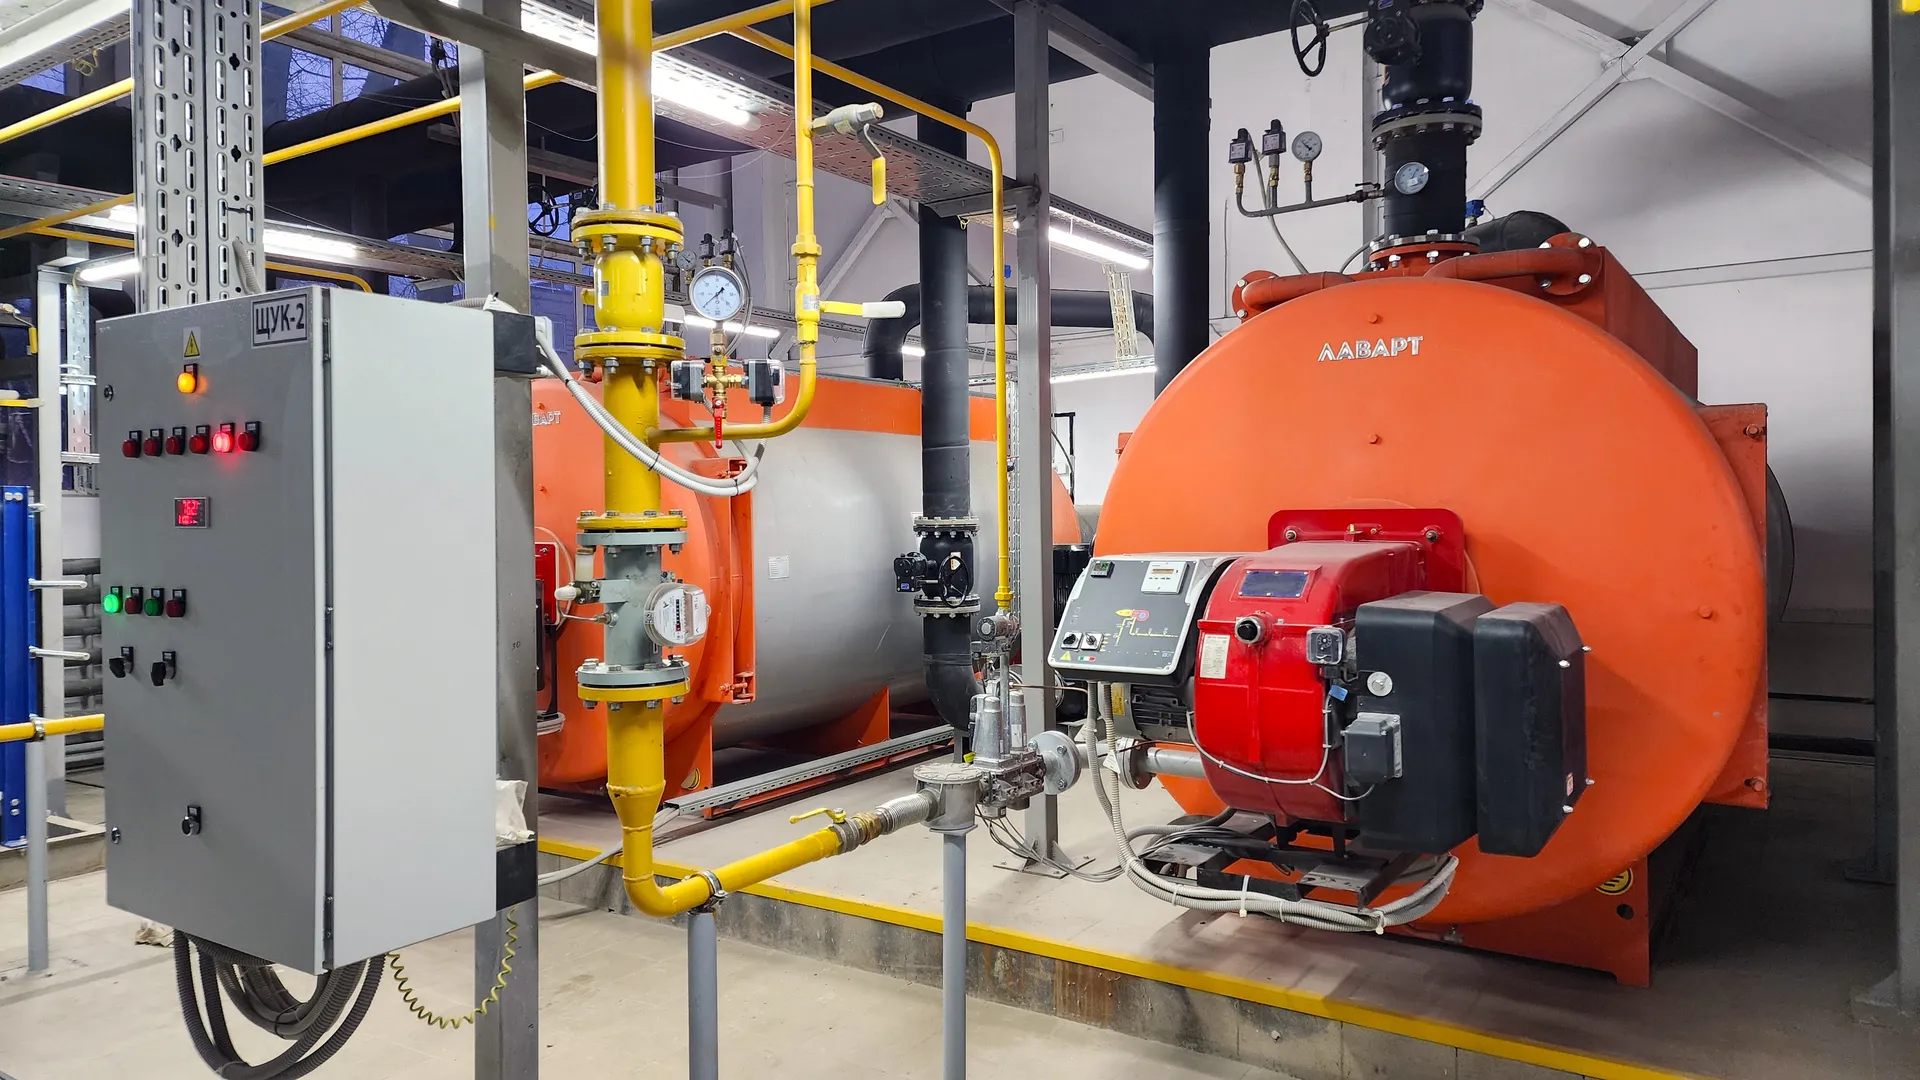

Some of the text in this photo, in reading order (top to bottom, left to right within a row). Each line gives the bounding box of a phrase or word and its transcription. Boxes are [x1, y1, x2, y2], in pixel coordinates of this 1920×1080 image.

[255, 303, 305, 339] ЩУК-2
[1317, 335, 1424, 362] ЛАВАРТ
[532, 411, 562, 425] ВАРТ
